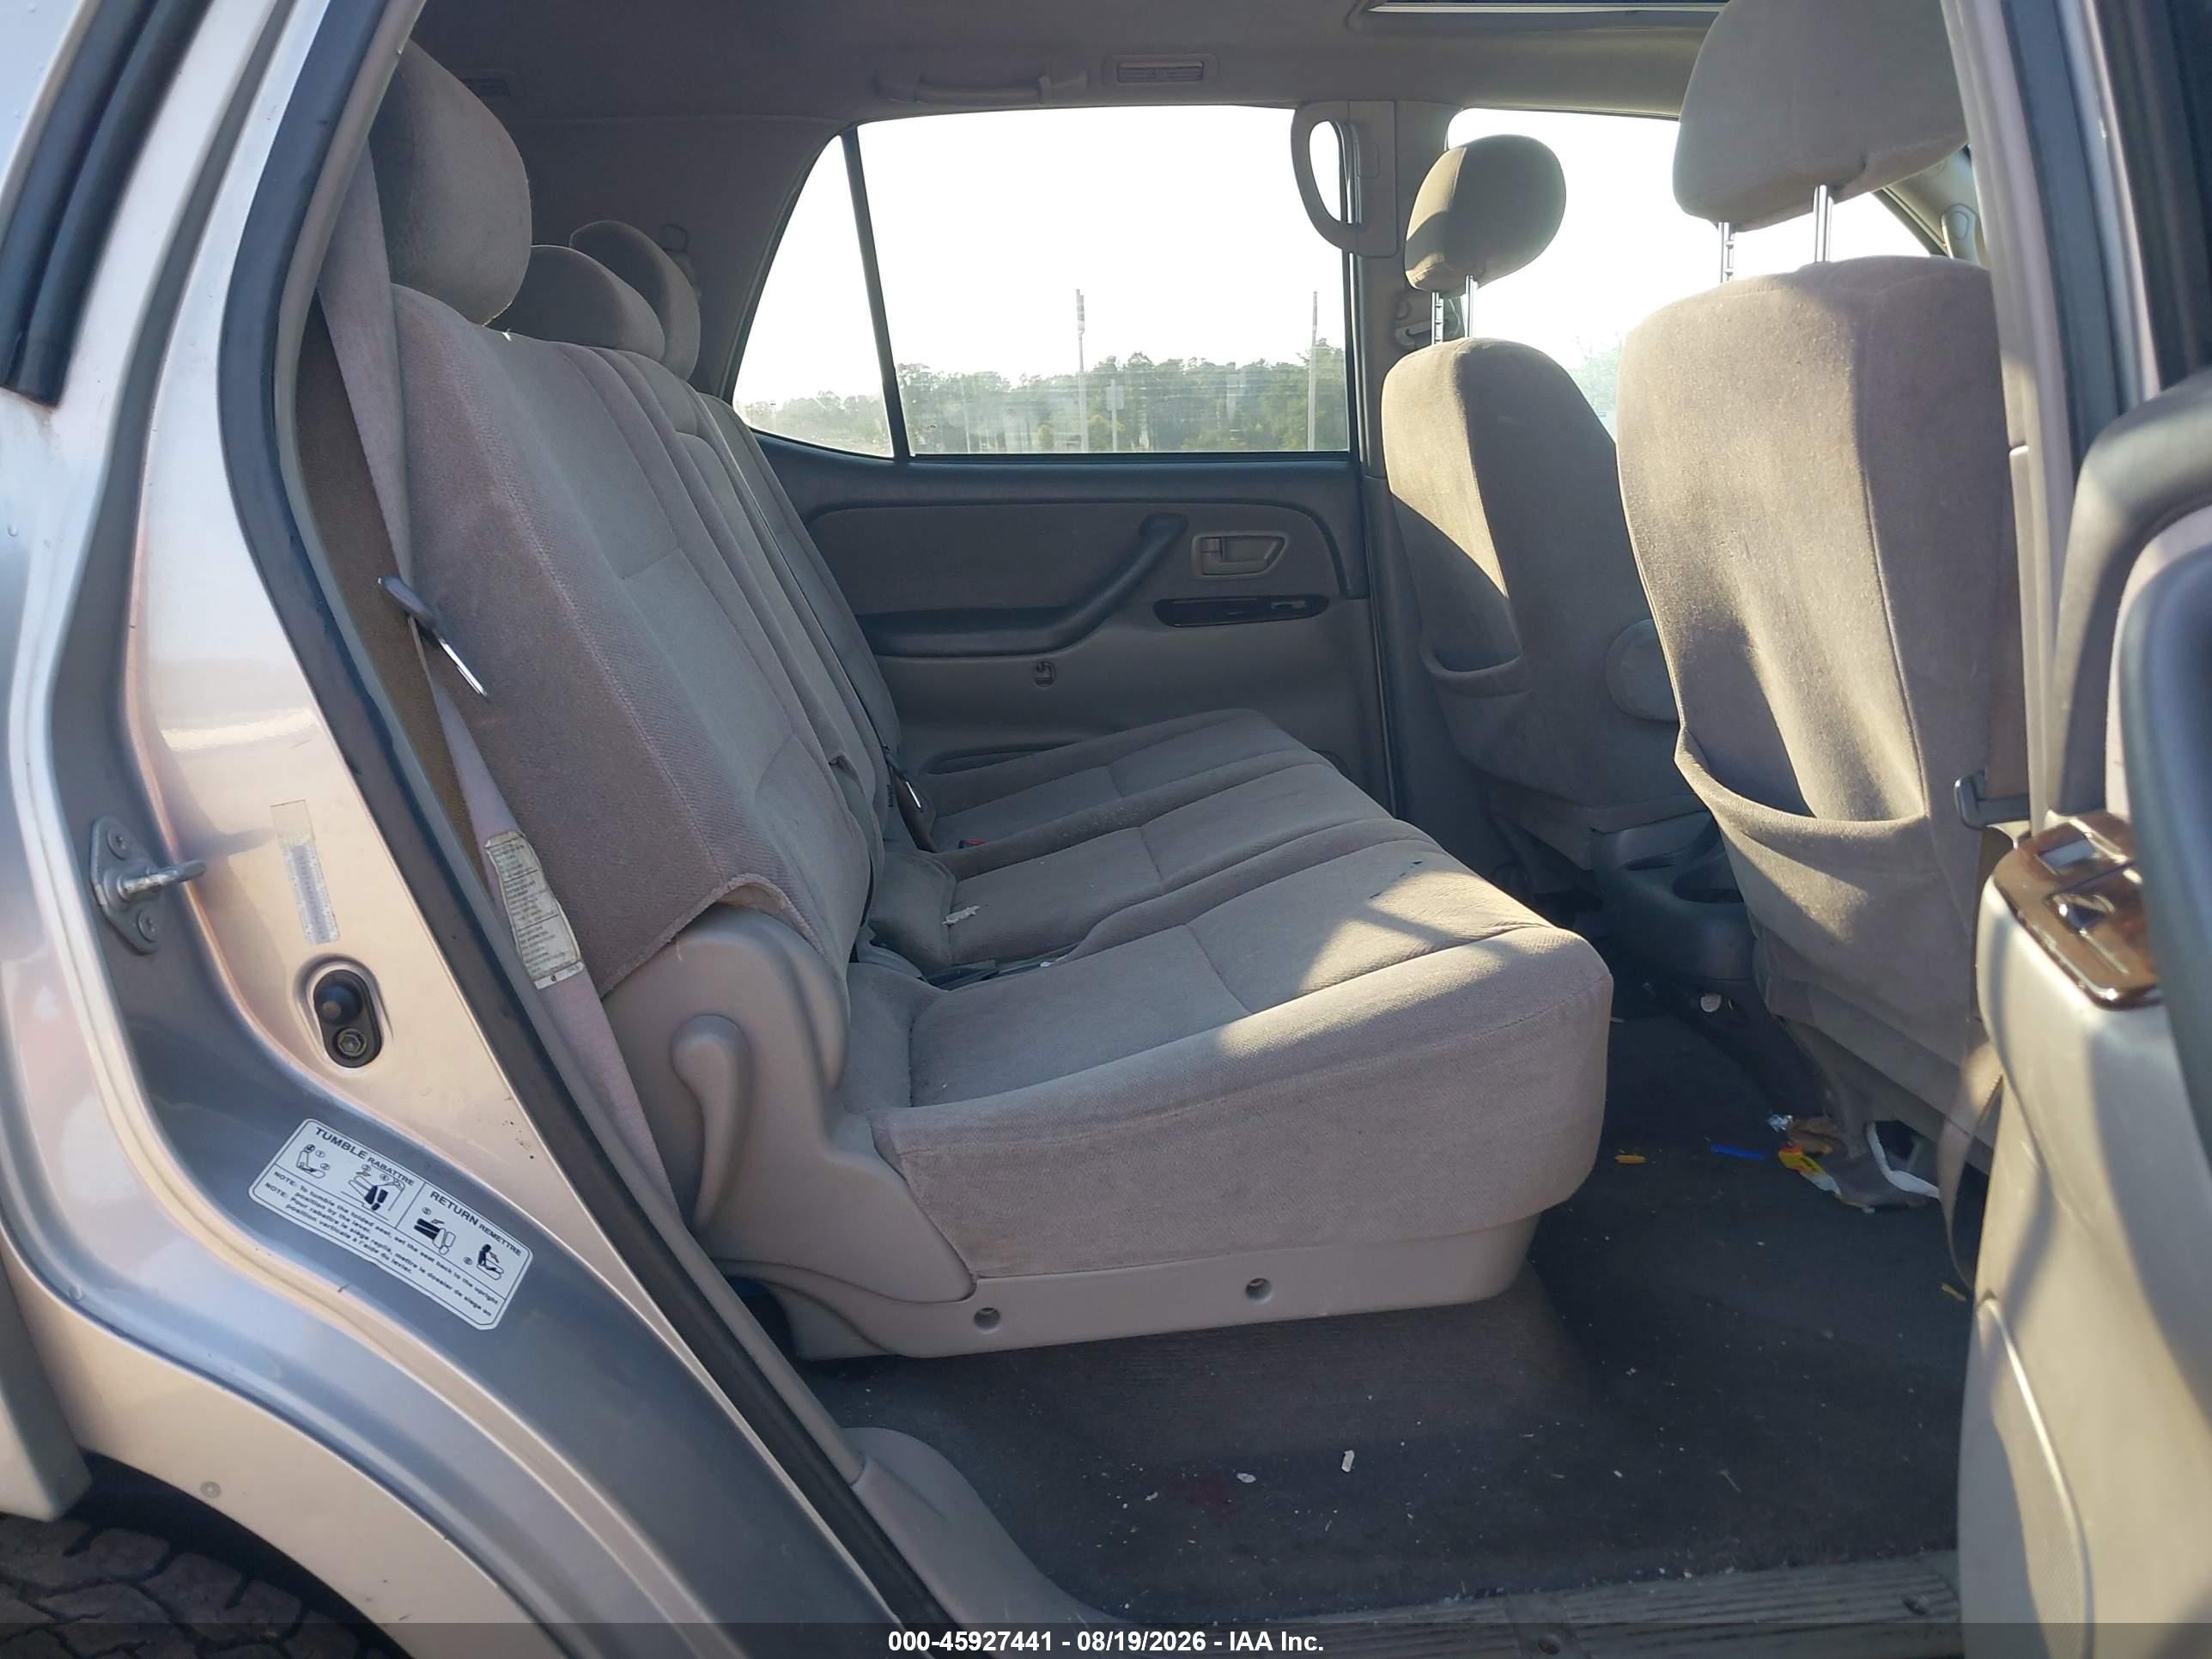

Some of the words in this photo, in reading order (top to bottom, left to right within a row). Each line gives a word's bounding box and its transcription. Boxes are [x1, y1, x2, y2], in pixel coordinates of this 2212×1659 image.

[316, 1127, 369, 1160] TUMBLE
[367, 1155, 416, 1187] RABATTRE
[285, 1204, 318, 1223] position
[319, 1221, 352, 1240] verticale
[380, 1253, 391, 1261] du
[295, 1193, 327, 1211] position
[327, 1208, 338, 1217] by
[338, 1213, 351, 1223] the
[430, 1191, 480, 1226] RETURN
[478, 1224, 523, 1257] REMETTRE
[290, 1197, 309, 1209] Pour
[309, 1208, 340, 1225] rabattre
[394, 1253, 419, 1269] mettre
[427, 1273, 453, 1291] dossier
[300, 1185, 309, 1194] To
[309, 1191, 336, 1207] tumble
[337, 1205, 349, 1214] the
[350, 1212, 375, 1228] folded
[394, 1237, 407, 1246] set
[407, 1243, 419, 1253] the
[420, 1252, 435, 1264] seat
[435, 1261, 453, 1275] back
[462, 1278, 474, 1288] the
[474, 1287, 499, 1305] upright
